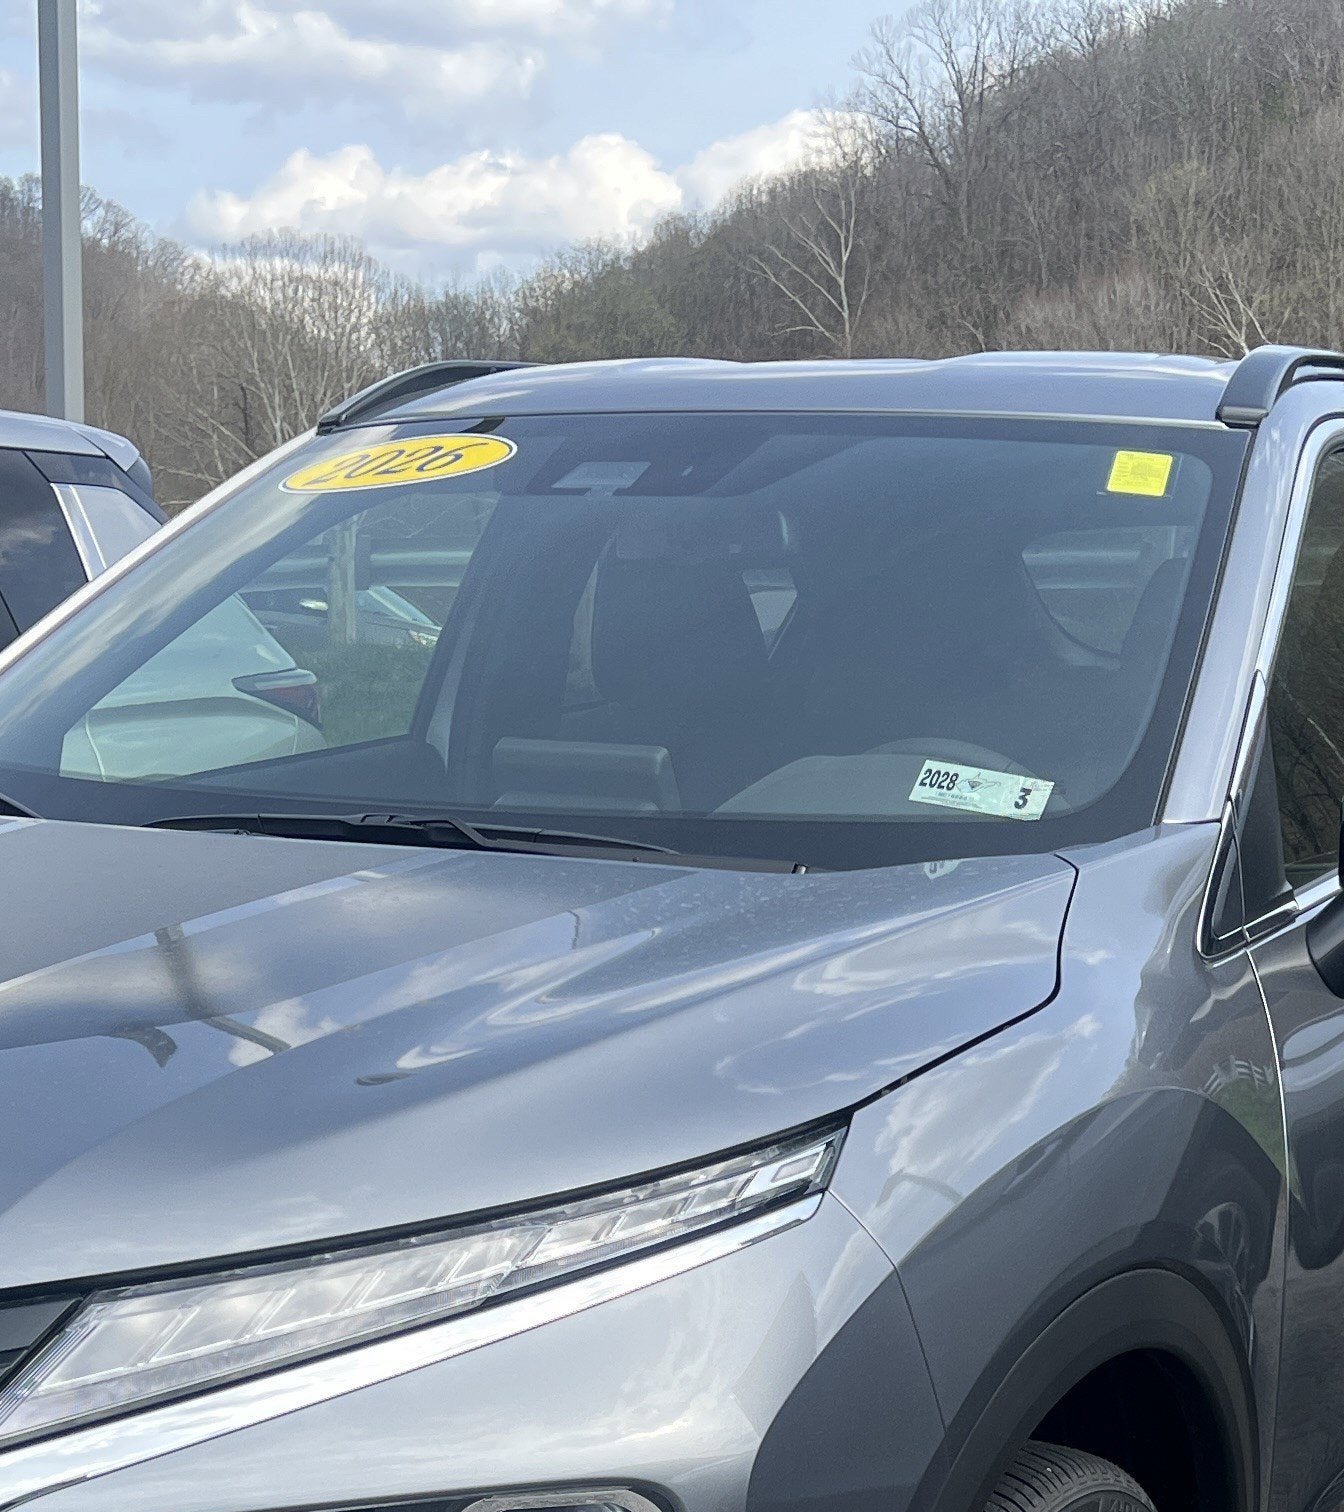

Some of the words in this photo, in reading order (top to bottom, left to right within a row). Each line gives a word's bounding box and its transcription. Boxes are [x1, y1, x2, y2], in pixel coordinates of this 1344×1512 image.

[301, 442, 489, 487] 2026
[918, 768, 960, 792] 2028
[1013, 787, 1033, 810] 3
